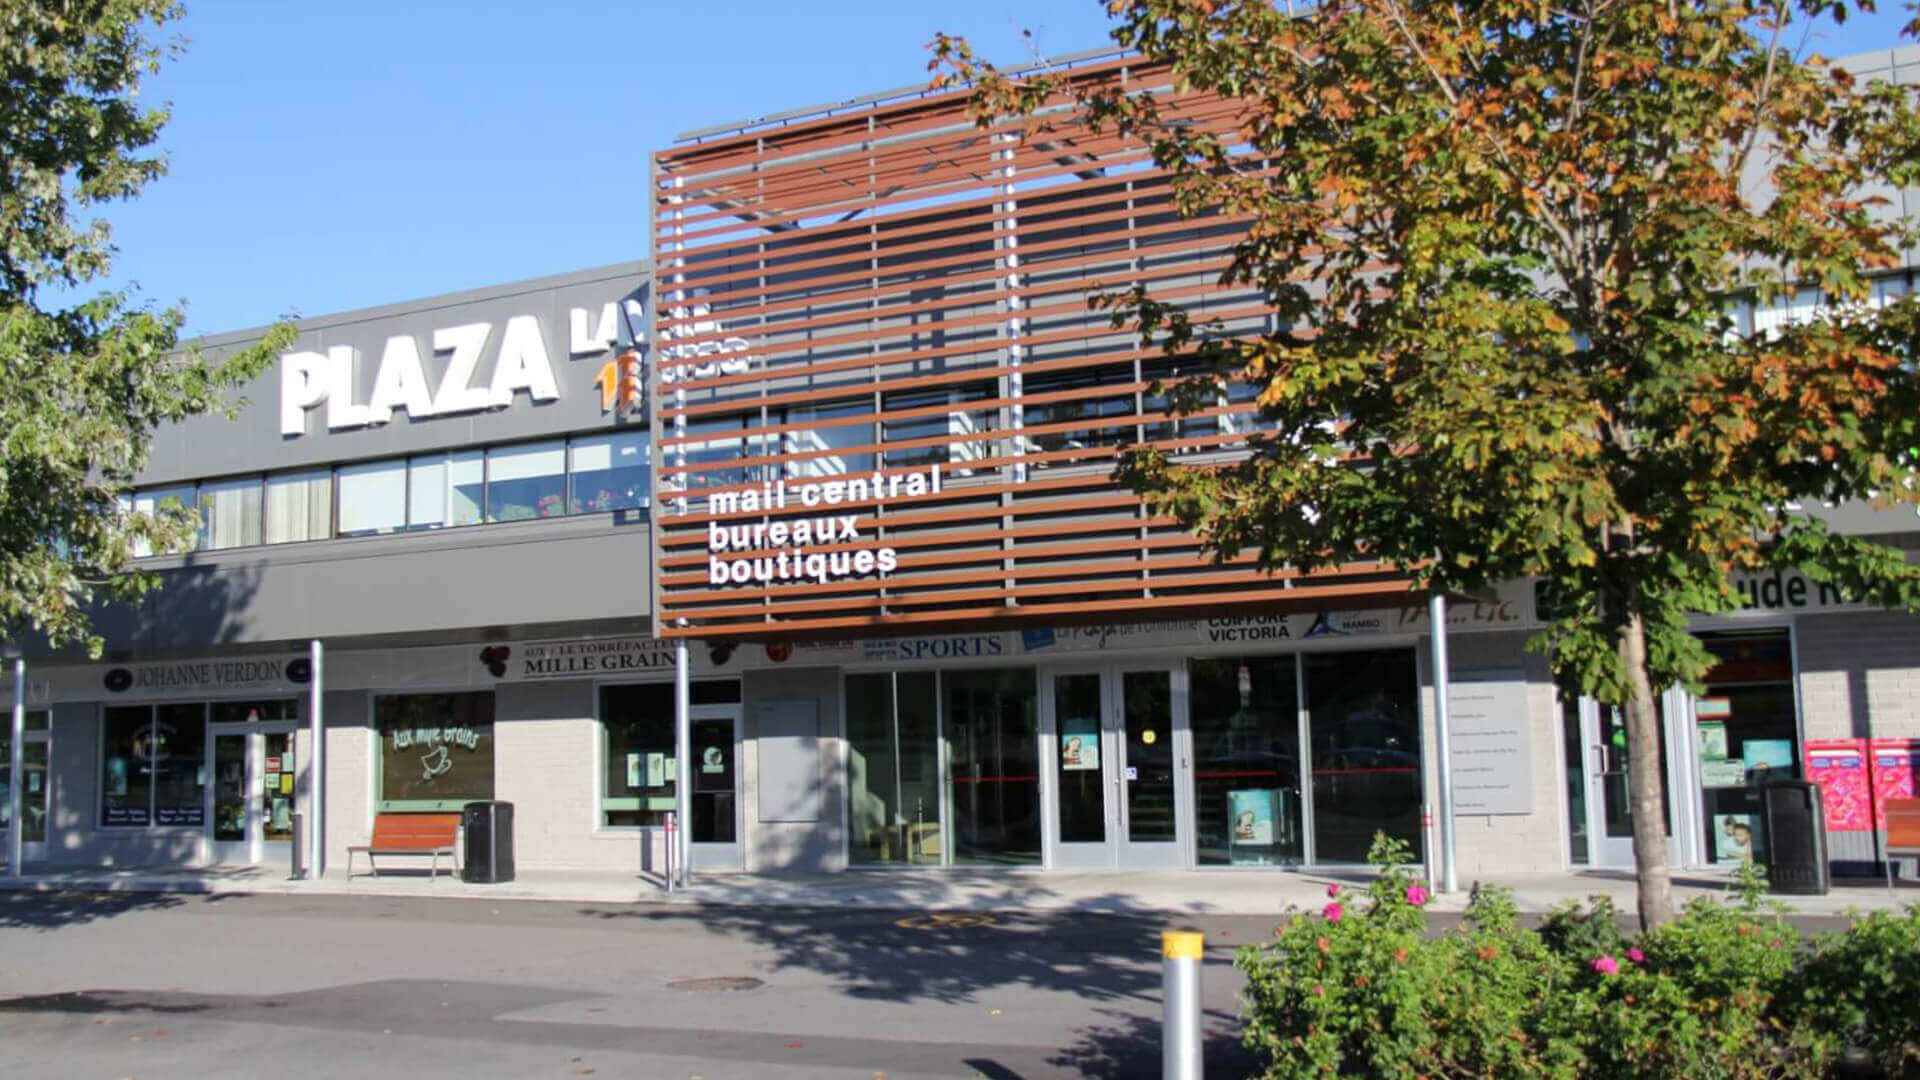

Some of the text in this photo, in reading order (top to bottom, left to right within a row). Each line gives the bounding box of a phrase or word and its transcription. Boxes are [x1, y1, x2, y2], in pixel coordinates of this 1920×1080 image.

[281, 315, 560, 435] PLAZA
[709, 464, 941, 516] mail central
[709, 515, 860, 551] bureaux
[709, 547, 897, 585] boutiques
[901, 636, 1002, 660] SPORTS
[1208, 625, 1290, 642] VICTORIA
[135, 660, 282, 688] JOHANNE VERDON
[524, 651, 690, 674] MILLE GRAIN
